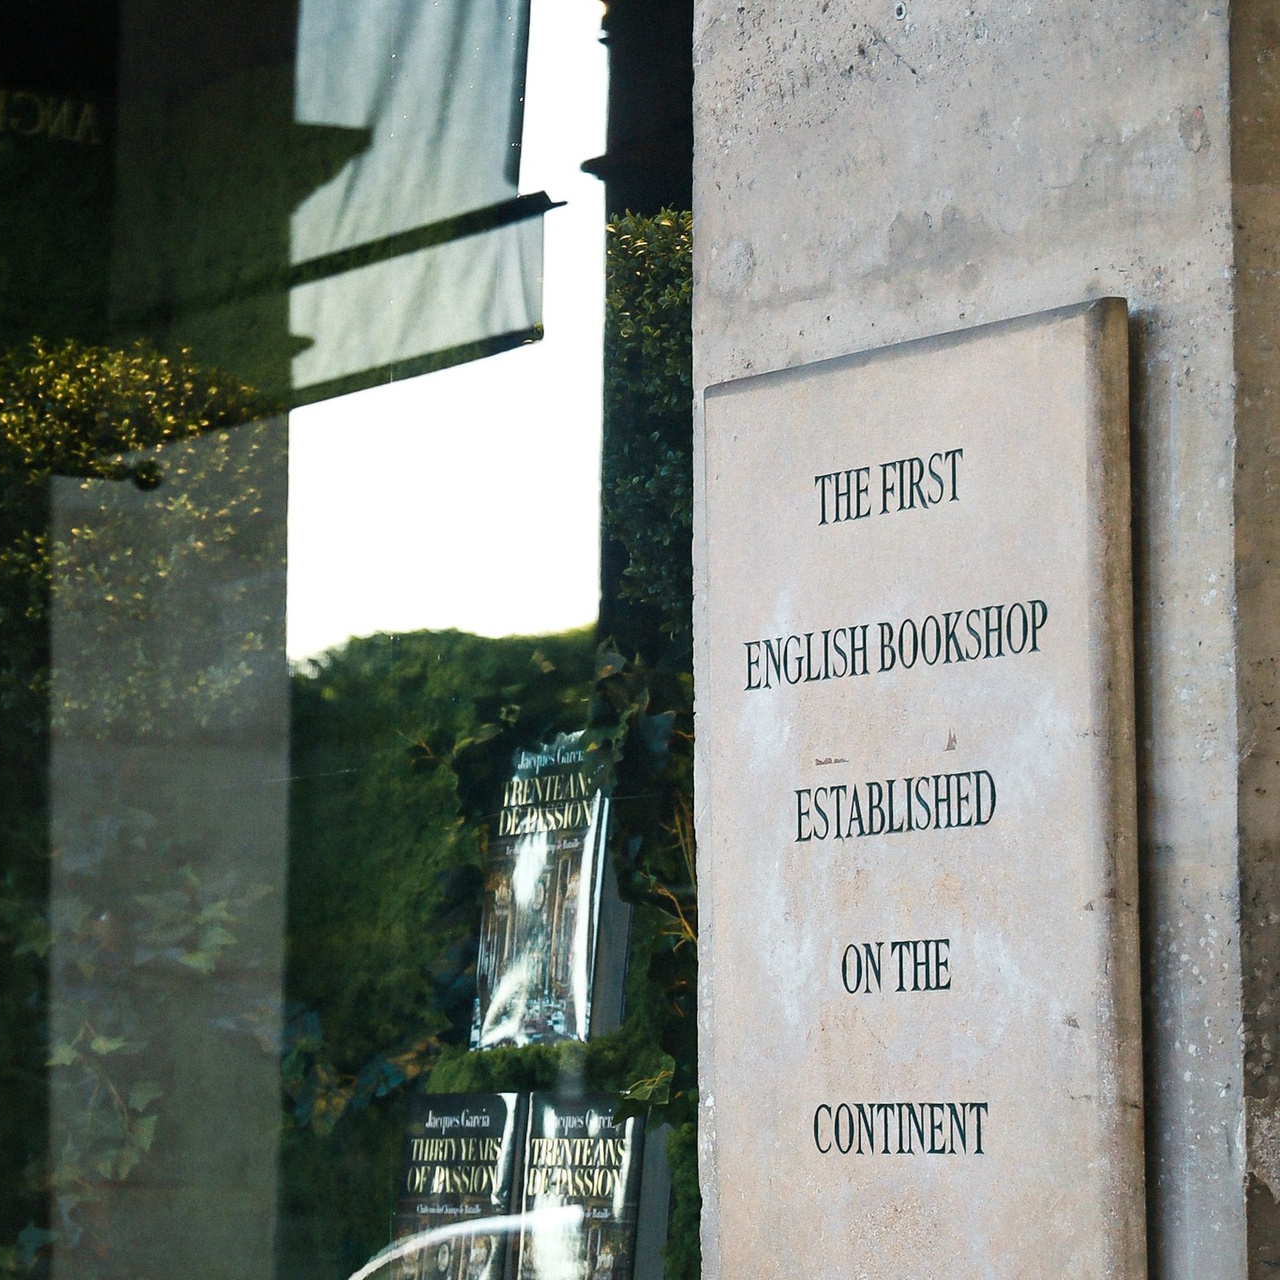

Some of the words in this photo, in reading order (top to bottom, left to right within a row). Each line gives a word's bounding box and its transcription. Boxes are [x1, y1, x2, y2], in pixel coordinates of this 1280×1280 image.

[815, 466, 872, 526] THE
[878, 448, 964, 516] FIRST
[743, 624, 870, 692] ENGLISH
[877, 599, 1048, 673] BOOKSHOP
[504, 775, 564, 807] TRENTE
[794, 769, 997, 842] ESTABLISHED
[499, 807, 522, 836] DE
[523, 800, 593, 833] PASSION
[841, 942, 885, 994] ON
[890, 938, 952, 992] THE
[425, 1110, 460, 1135] Jacques
[461, 1108, 490, 1128] Garcia
[813, 1101, 989, 1156] CONTINENT
[411, 1137, 457, 1162] THIRTY
[459, 1137, 502, 1162] YEARS
[531, 1138, 594, 1166] TRENTE
[593, 1138, 627, 1166] ANS
[407, 1165, 431, 1193] OF
[431, 1165, 498, 1194] PASSION
[528, 1167, 553, 1196] DE
[553, 1167, 622, 1197] PASSION
